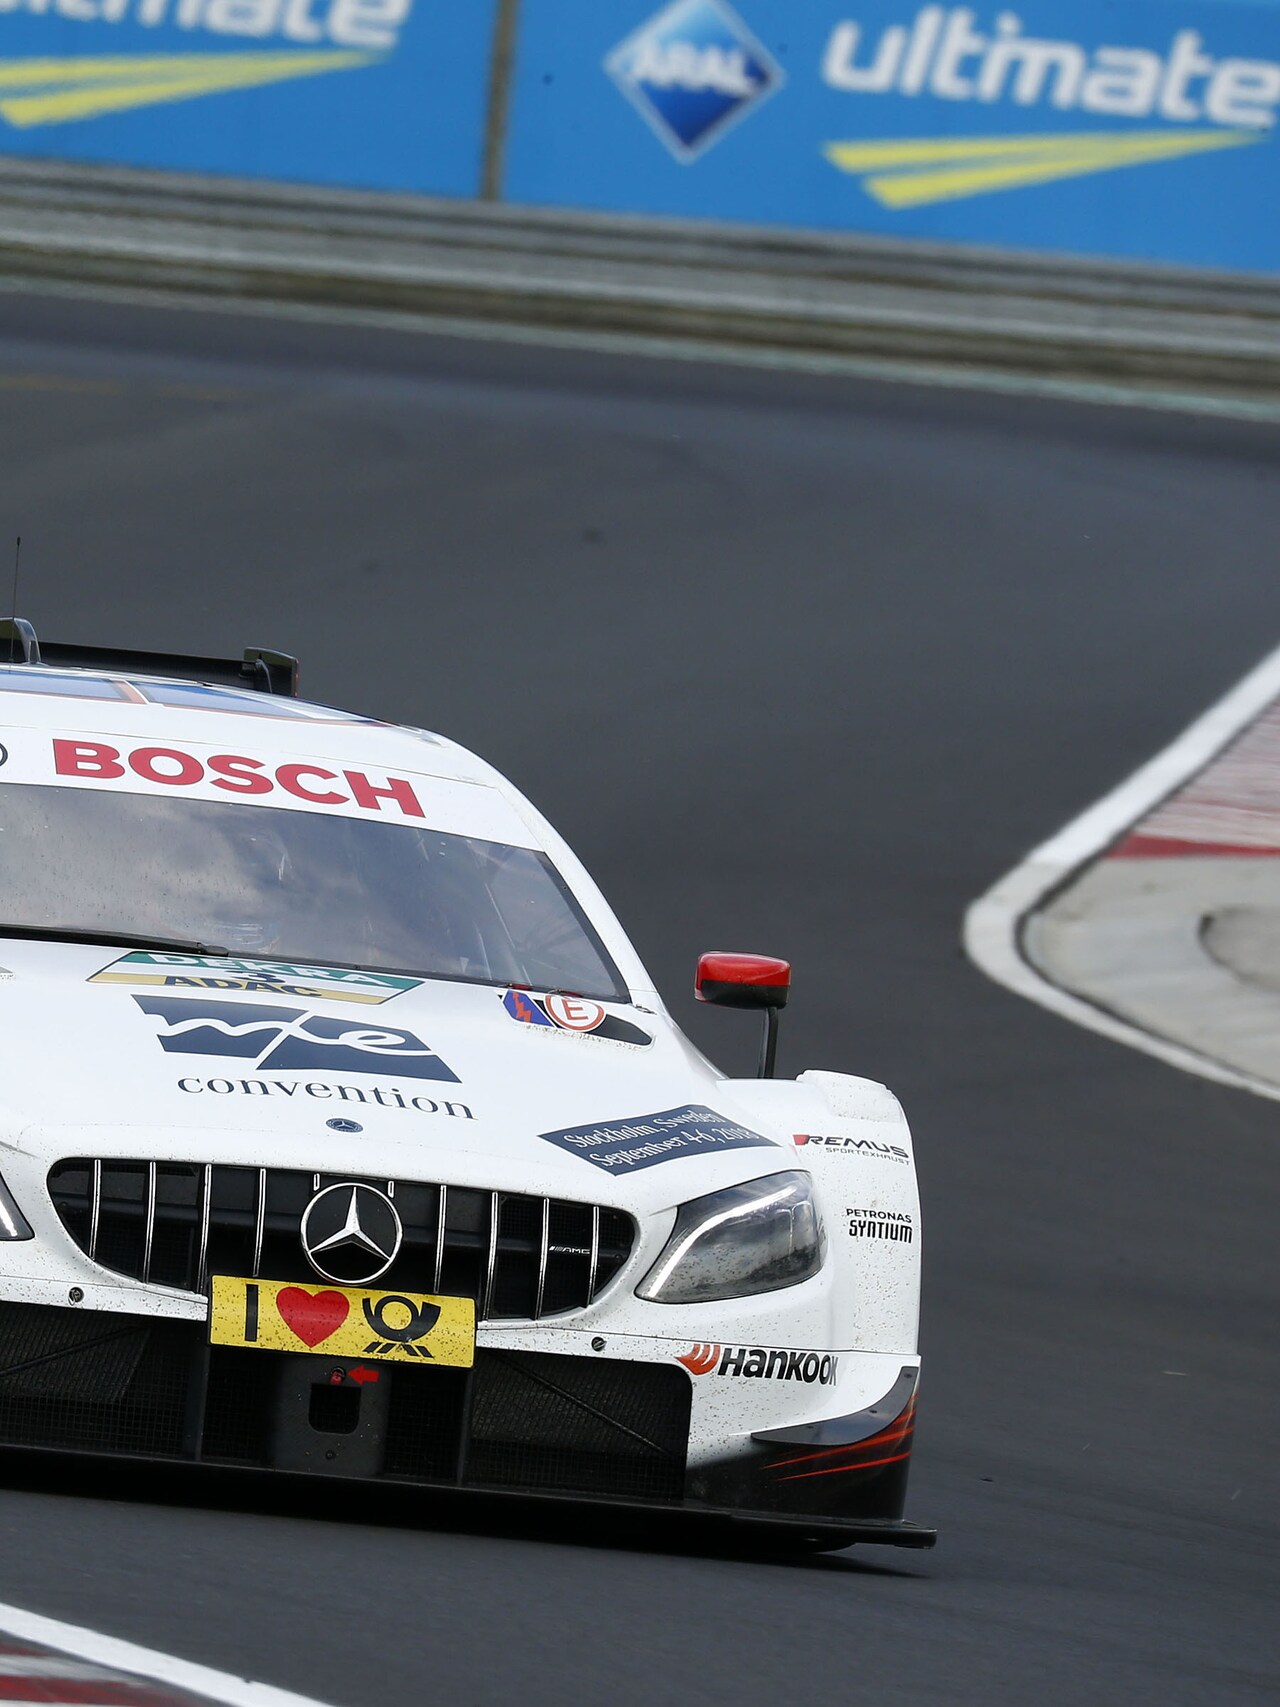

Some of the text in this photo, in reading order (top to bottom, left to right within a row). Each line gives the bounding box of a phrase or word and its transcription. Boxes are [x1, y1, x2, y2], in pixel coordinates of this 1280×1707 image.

[820, 7, 1280, 128] ultimate
[52, 738, 426, 819] BOSCH
[147, 953, 393, 986] DEKRA
[164, 975, 322, 997] ADAC
[561, 998, 589, 1021] E
[177, 1076, 479, 1120] convention
[564, 1110, 726, 1148] Stockholm, Sweden
[589, 1136, 688, 1167] September
[805, 1135, 909, 1158] REMUS
[825, 1147, 910, 1166] SPORTEXHAUST
[846, 1208, 912, 1224] PETRONAS
[849, 1219, 912, 1244] SYNTIUM
[244, 1283, 260, 1343] I
